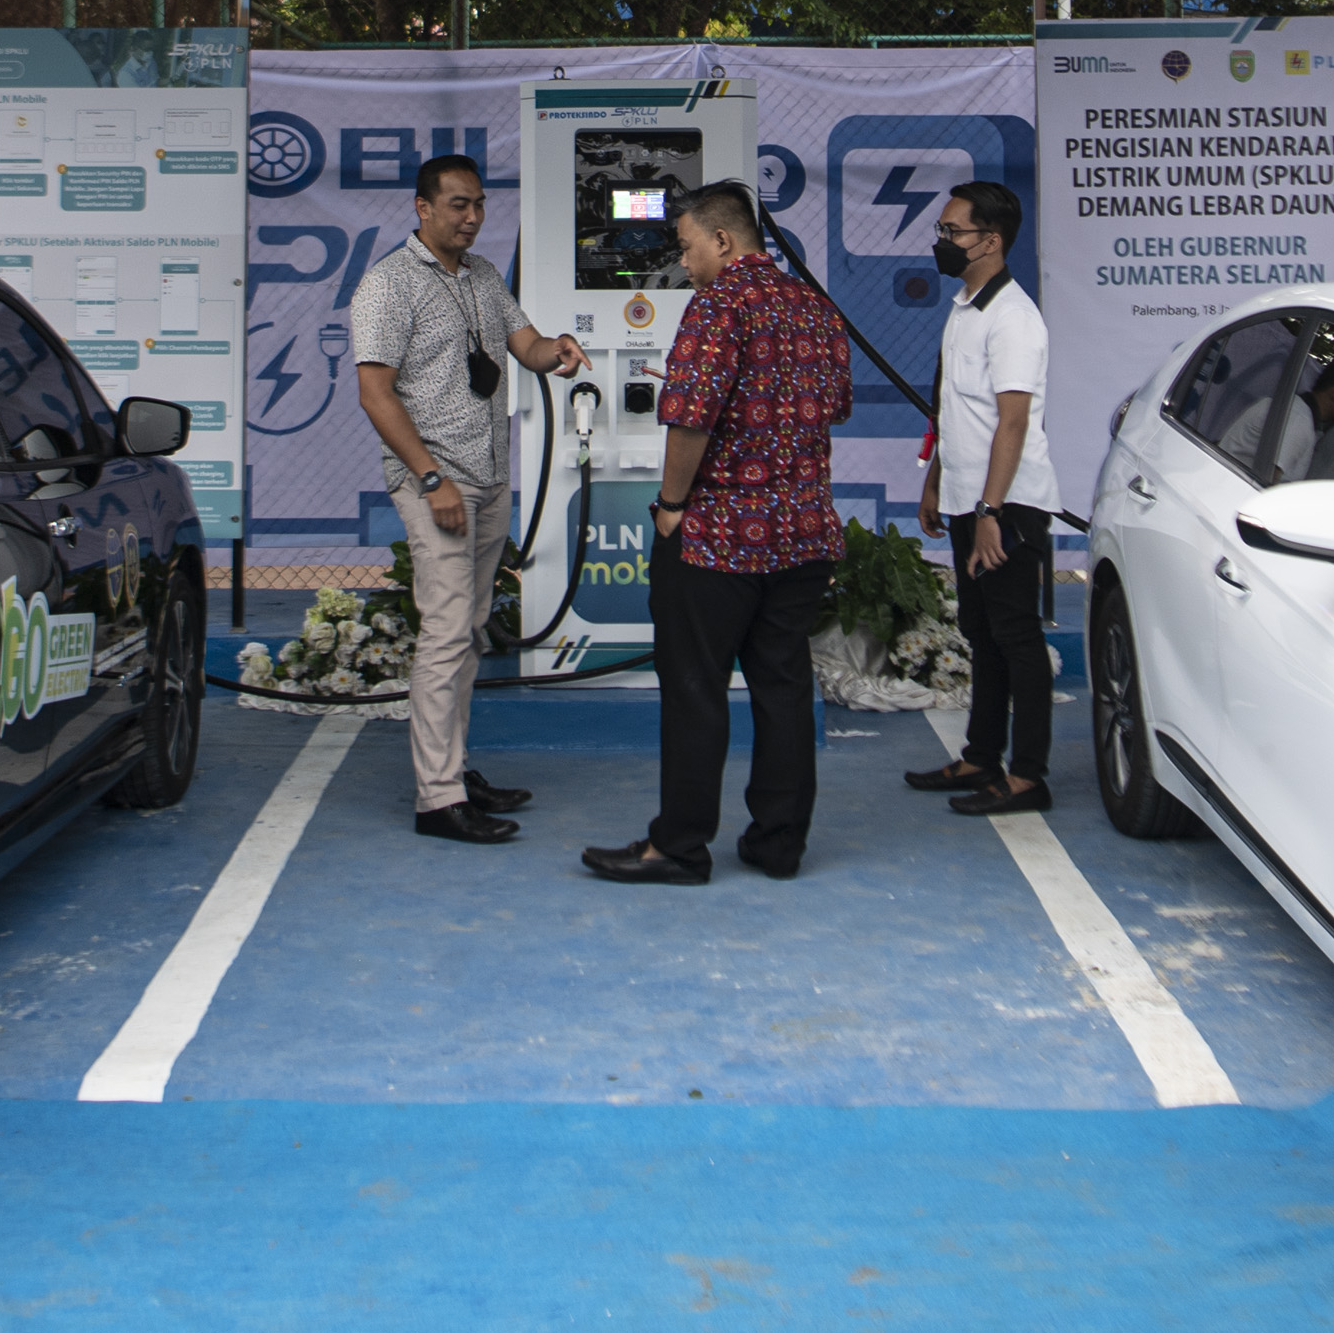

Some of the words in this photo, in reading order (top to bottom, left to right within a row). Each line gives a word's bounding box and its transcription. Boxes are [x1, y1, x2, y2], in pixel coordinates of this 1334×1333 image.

[167, 43, 234, 56] SPKLU
[201, 58, 233, 69] PLN
[12, 95, 48, 104] Mobile
[549, 111, 607, 119] PROTEKSINDO
[635, 117, 658, 125] PLN
[1085, 107, 1222, 129] PERESMIAN
[1227, 106, 1328, 128] STASIUN
[1065, 137, 1193, 159] PENGISIAN
[1072, 166, 1161, 188] LISTRIK
[1167, 166, 1245, 187] UMUM
[1078, 195, 1184, 217] DEMANG
[1190, 195, 1266, 216] LEBAR
[4, 237, 38, 247] SPKLU
[40, 237, 82, 248] (Setelah
[83, 237, 125, 247] Aktivasi
[126, 237, 155, 247] Saldo
[157, 237, 178, 247] PLN
[180, 237, 220, 248] Mobile)
[1113, 237, 1174, 257] OLEH
[1180, 235, 1308, 257] GUBERNUR
[1096, 265, 1221, 286] SUMATERA
[1227, 263, 1326, 285] SELATAN
[1132, 304, 1200, 318] Palembang,
[1202, 304, 1217, 315] 18
[49, 623, 93, 660] GREEN
[45, 667, 89, 698] ELECTRIC
